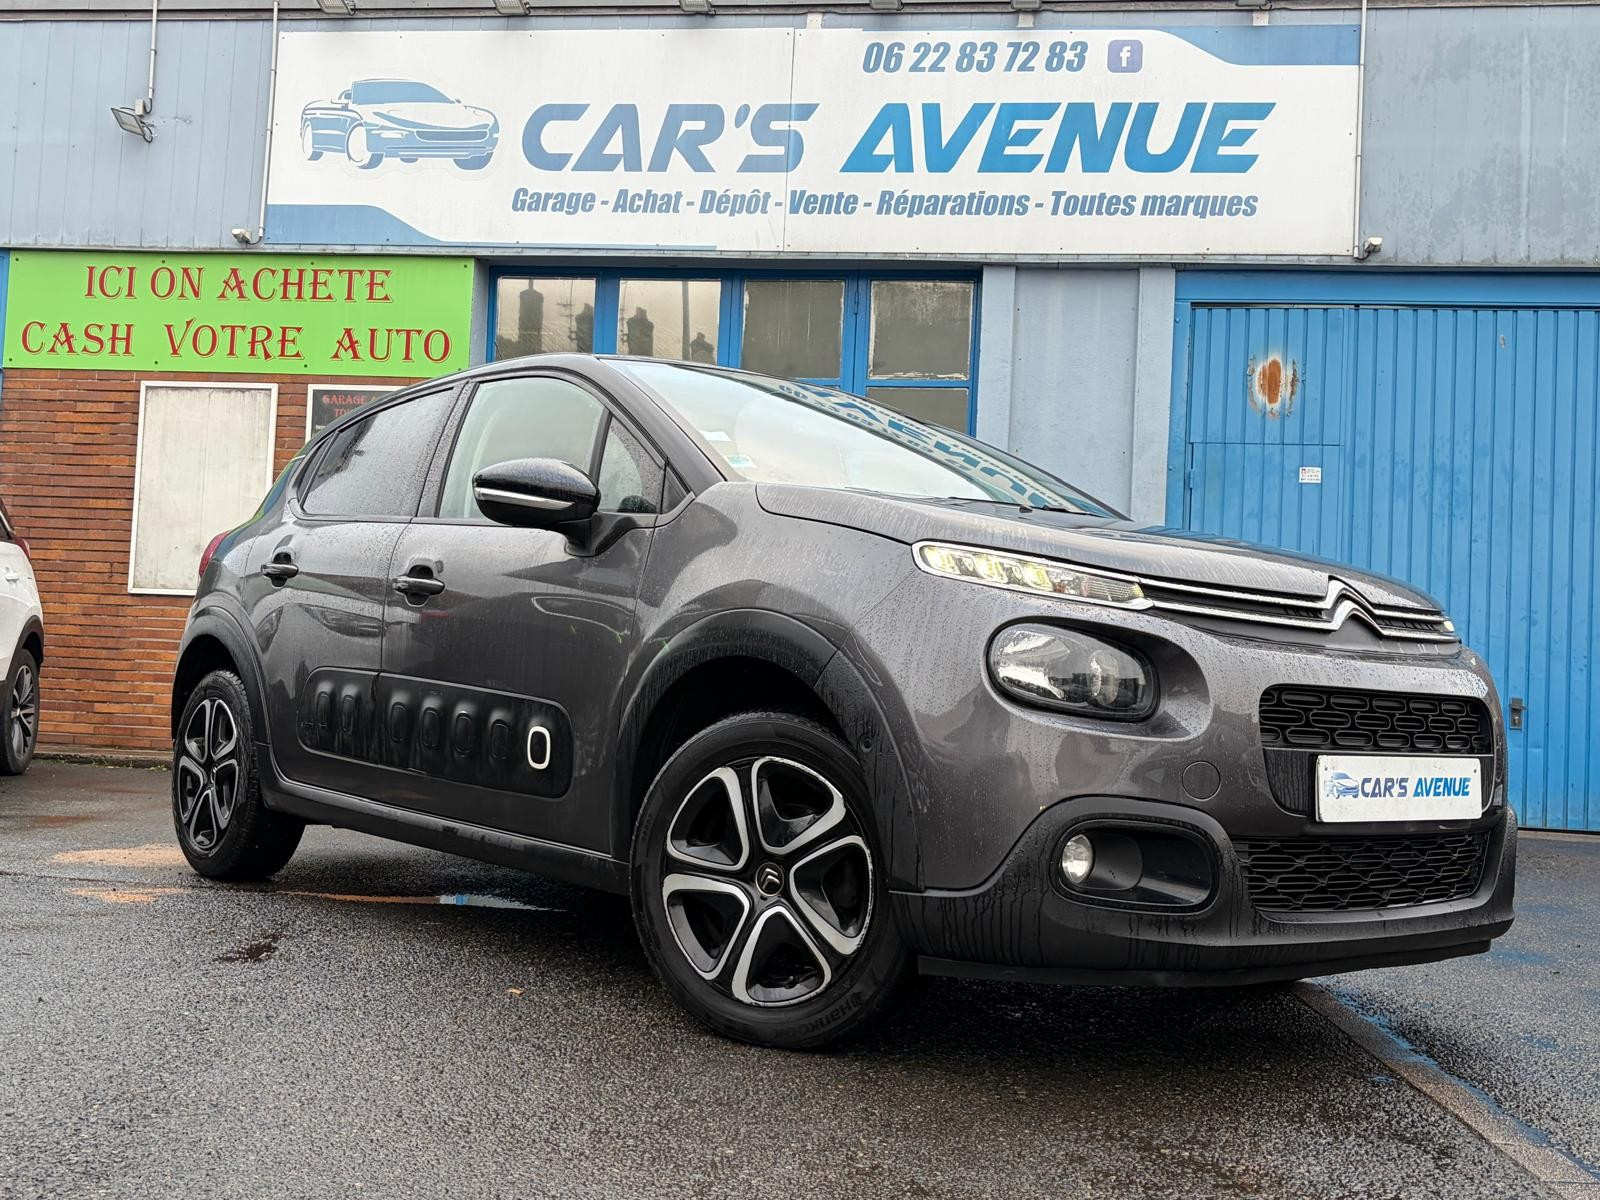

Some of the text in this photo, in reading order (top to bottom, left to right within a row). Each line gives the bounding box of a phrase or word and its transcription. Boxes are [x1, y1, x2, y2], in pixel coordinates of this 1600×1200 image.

[861, 41, 1089, 73] 06 22 83 72 83
[522, 102, 1277, 173] CAR'S AVENUE
[511, 187, 596, 216] Garage
[612, 189, 683, 214] Achat
[699, 188, 772, 217] Dépôt
[788, 190, 858, 214] Vente
[876, 190, 1030, 218] Réparations
[1050, 190, 1137, 217] Toutes
[1139, 191, 1259, 219] marques
[84, 266, 393, 303] ICI ON ACHETE
[21, 317, 452, 363] CASH VOTRE AUTO
[1360, 777, 1471, 798] CAR'S AVENUE
